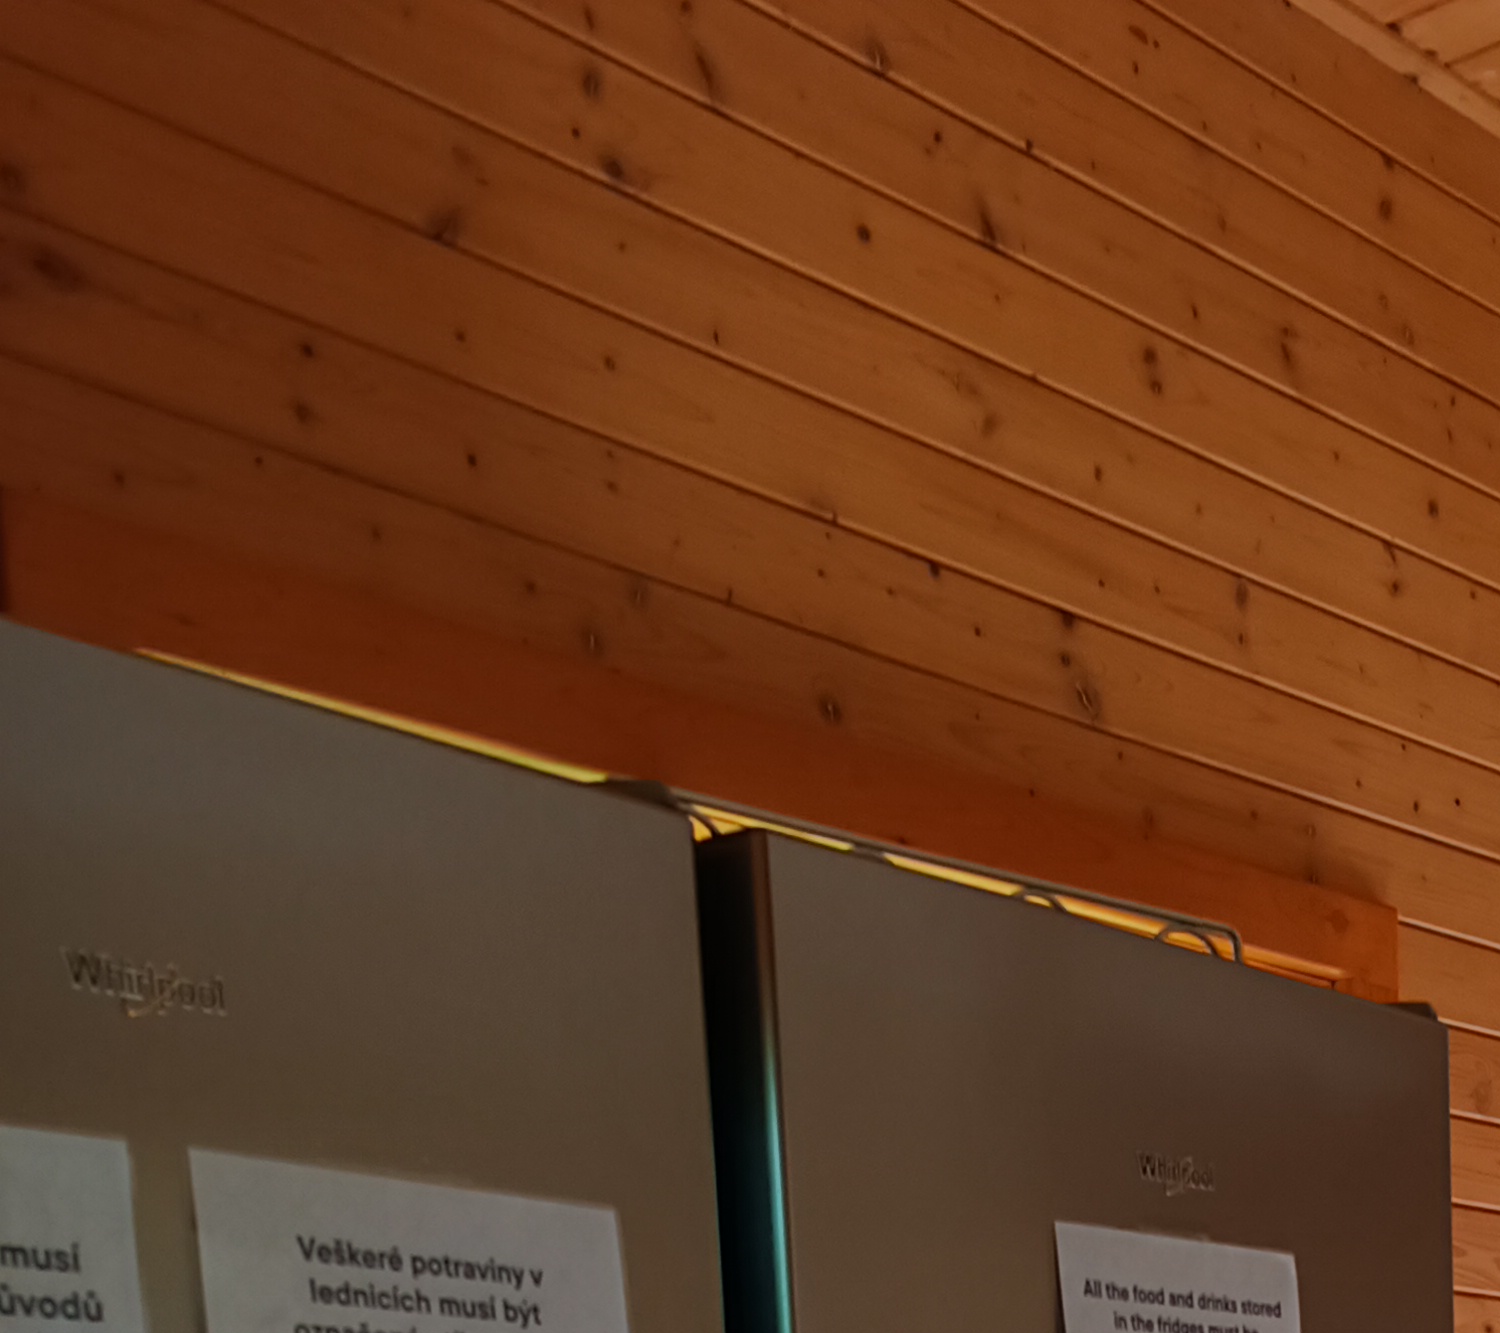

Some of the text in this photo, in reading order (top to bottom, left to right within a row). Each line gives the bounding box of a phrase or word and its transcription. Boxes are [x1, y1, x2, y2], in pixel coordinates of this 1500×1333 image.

[297, 1234, 543, 1291] Veškeré potraviny v
[309, 1279, 541, 1329] lednicích musí být
[1084, 1279, 1282, 1318] All the food and drinks stored
[1114, 1312, 1127, 1330] in
[1131, 1313, 1154, 1332] the
